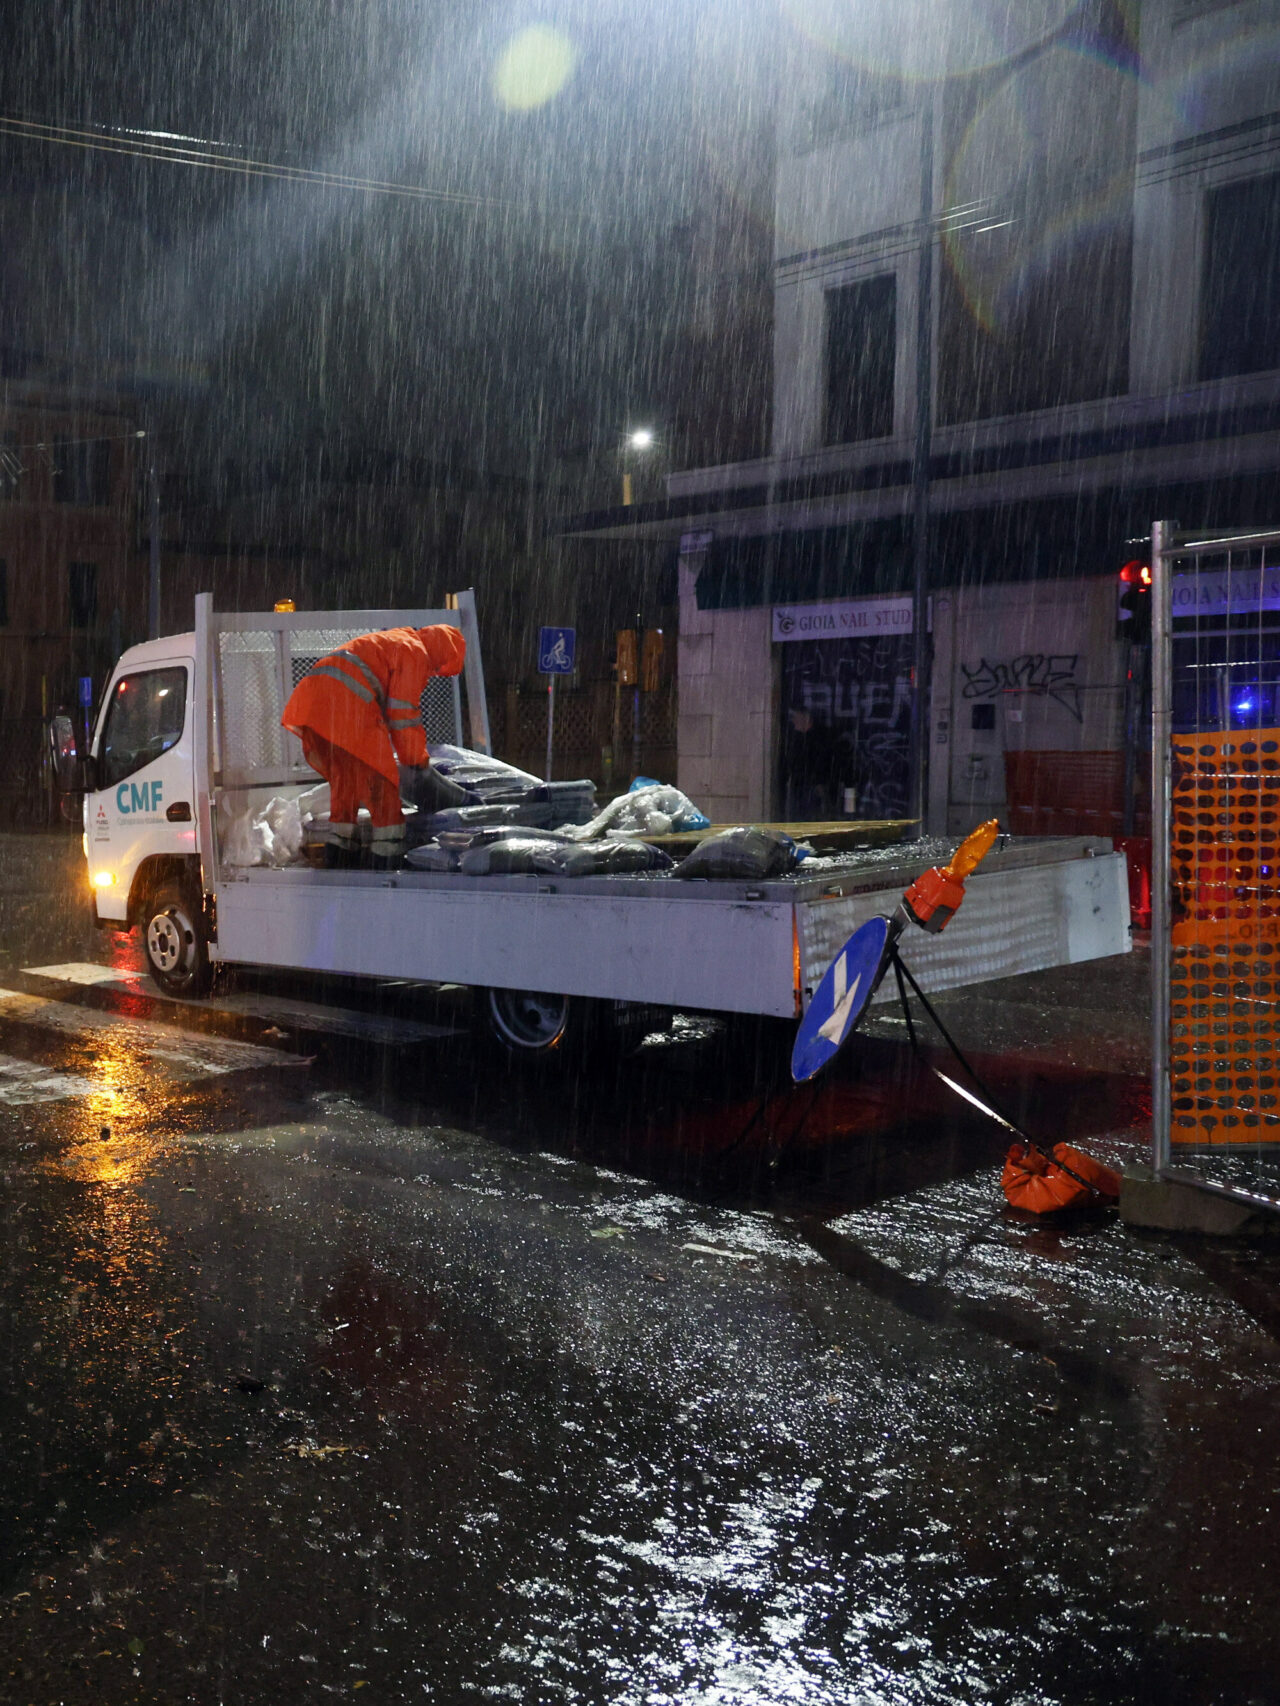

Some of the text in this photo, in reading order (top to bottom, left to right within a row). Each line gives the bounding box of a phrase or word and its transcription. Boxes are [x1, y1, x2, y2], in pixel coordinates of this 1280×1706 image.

[799, 608, 911, 631] GIOIA NAIL STUD
[116, 780, 163, 814] CMF
